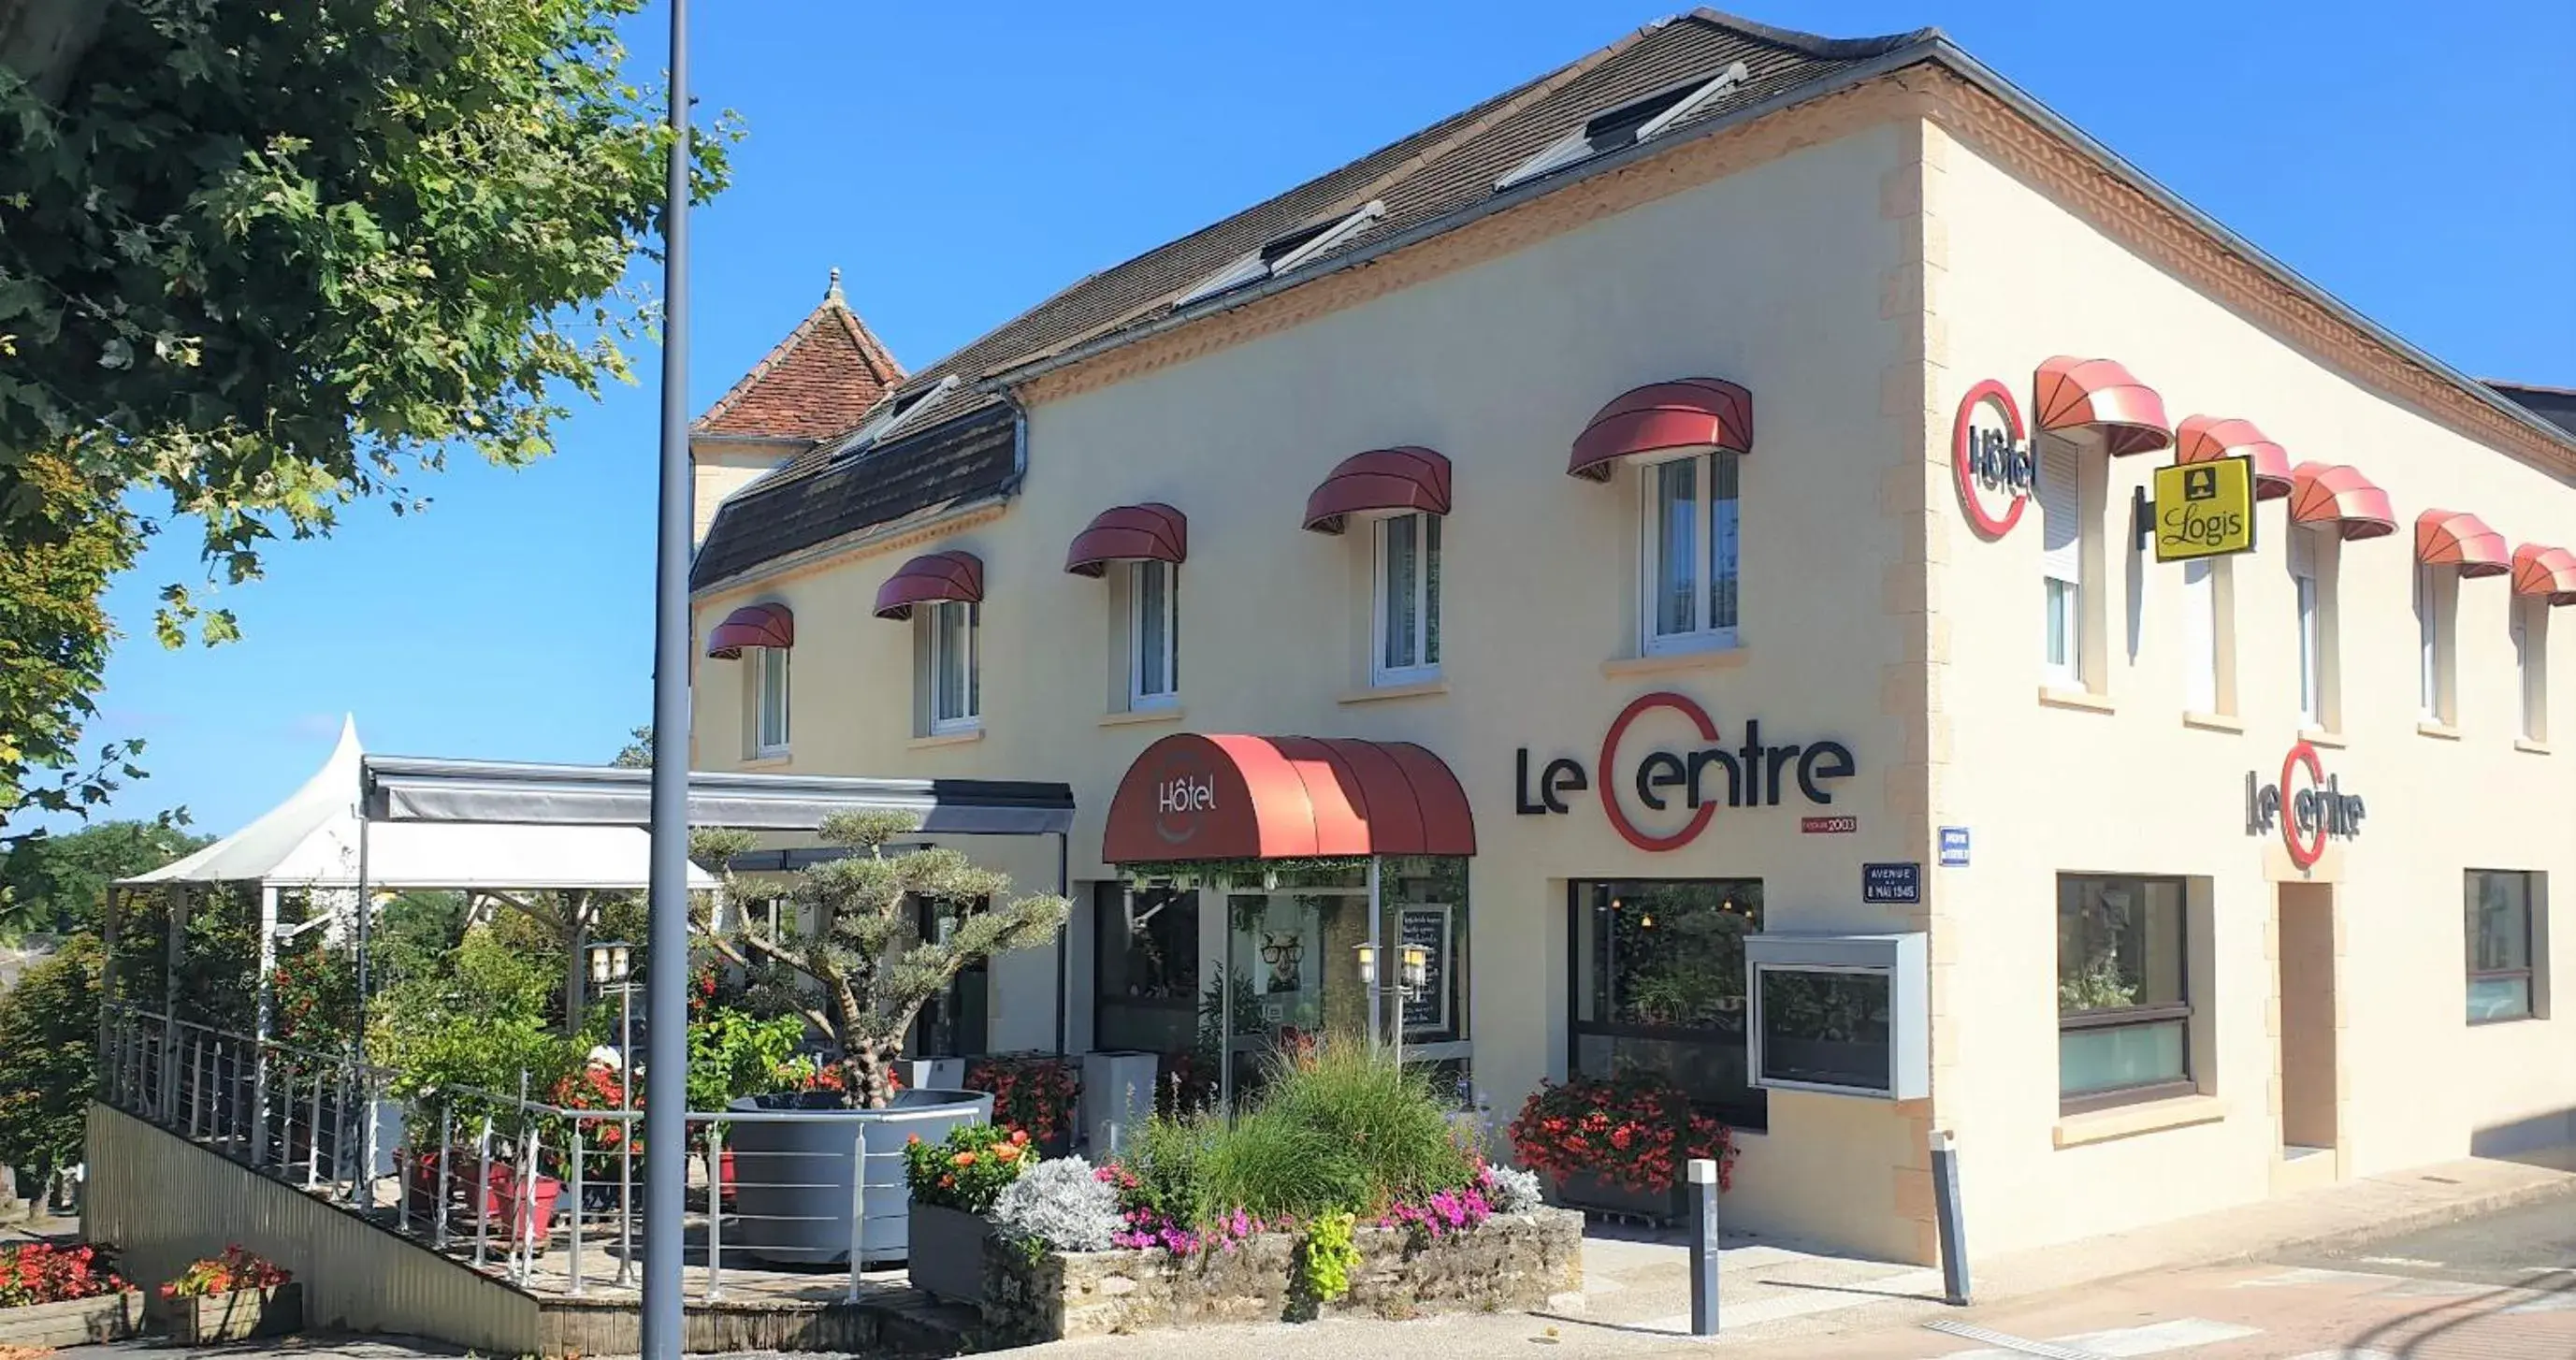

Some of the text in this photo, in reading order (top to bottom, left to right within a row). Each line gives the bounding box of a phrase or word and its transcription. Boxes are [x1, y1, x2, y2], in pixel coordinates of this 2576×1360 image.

[1969, 426, 2036, 489] Hôtel
[2162, 502, 2242, 546] Logis
[1516, 691, 1856, 852] Le Centre
[1160, 774, 1216, 813] Hôtel
[1828, 818, 1855, 832] 2003
[1871, 868, 1911, 878] AVENUE
